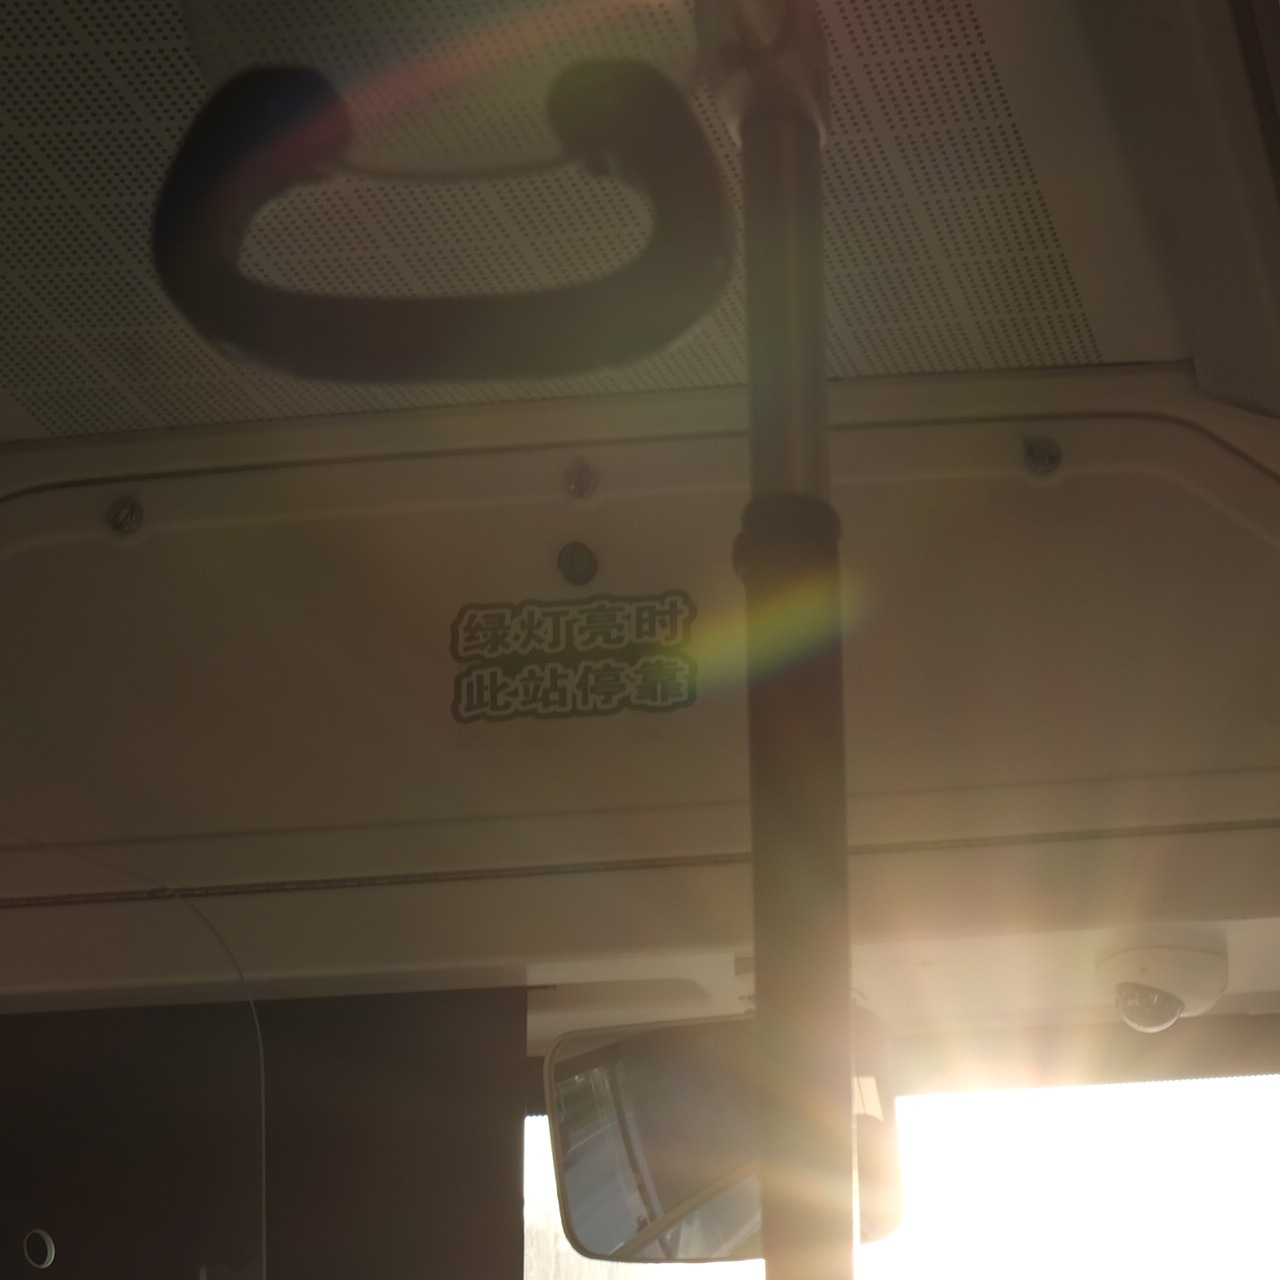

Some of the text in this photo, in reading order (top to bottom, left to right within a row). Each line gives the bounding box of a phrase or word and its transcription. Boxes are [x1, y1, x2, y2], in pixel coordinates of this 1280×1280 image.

[461, 598, 686, 656] 绿灯亮时
[462, 659, 686, 714] 此站停靠
